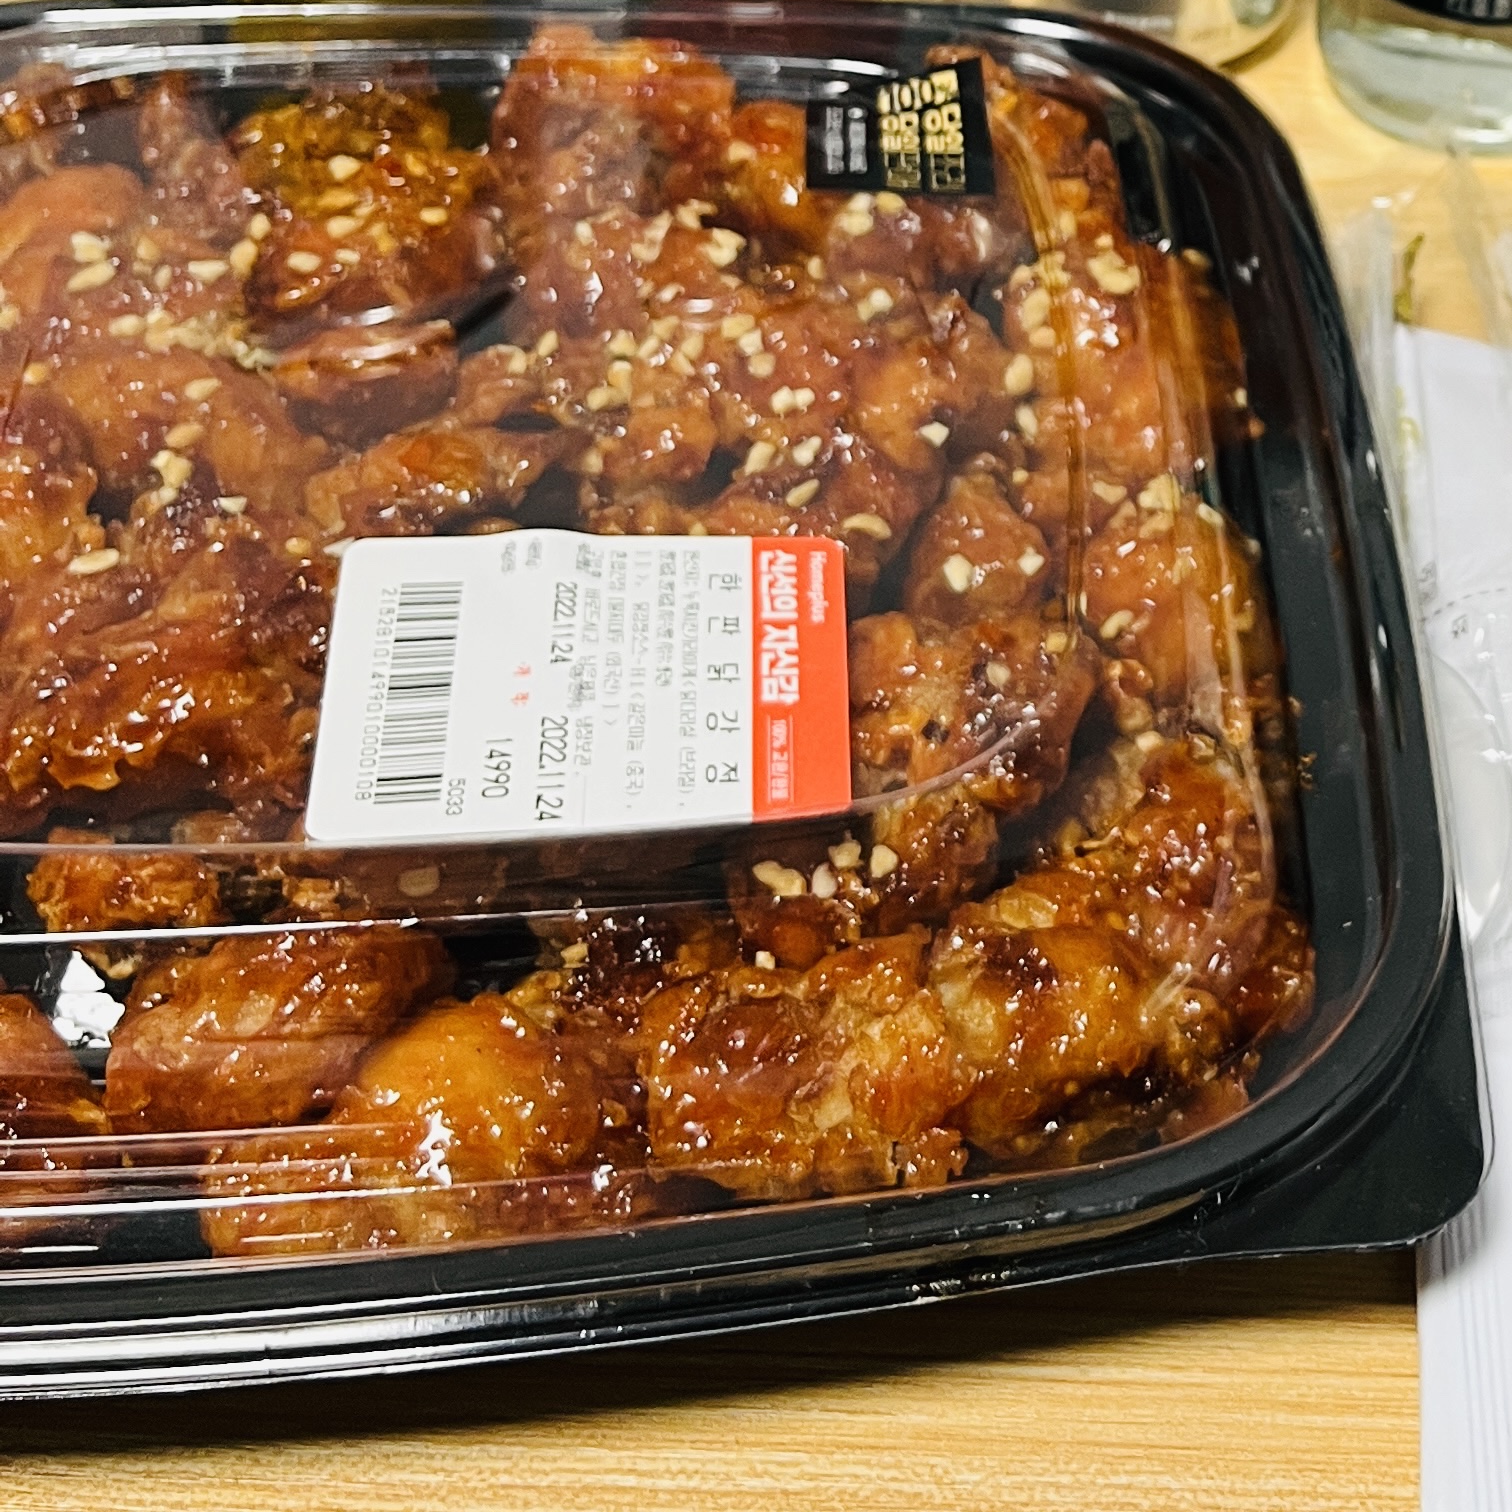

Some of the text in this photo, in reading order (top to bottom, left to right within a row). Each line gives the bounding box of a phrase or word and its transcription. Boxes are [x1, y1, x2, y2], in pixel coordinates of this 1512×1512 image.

[759, 549, 799, 619] 신선의
[807, 550, 829, 623] Homeplus
[550, 581, 578, 665] 2022.11.24
[760, 624, 800, 705] 자신감
[445, 777, 466, 816] 5033
[481, 737, 513, 799] 14990
[534, 716, 569, 821] 2022.11.24
